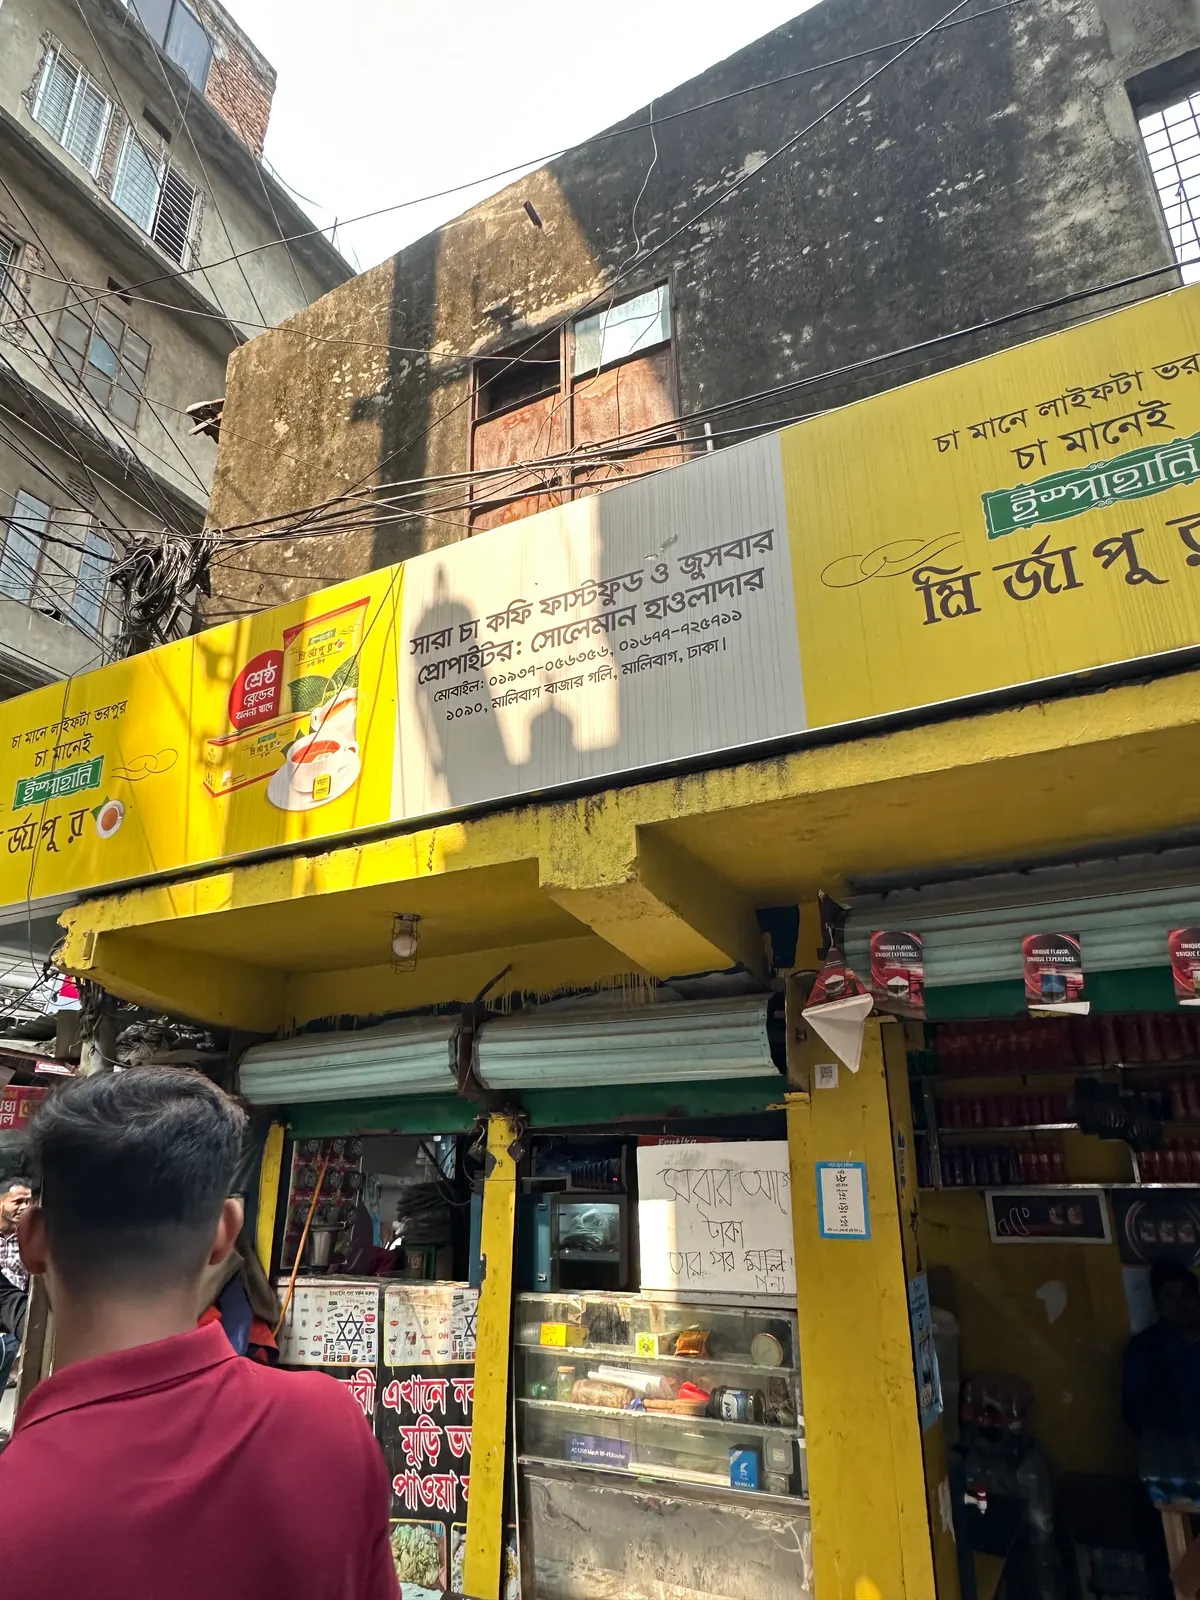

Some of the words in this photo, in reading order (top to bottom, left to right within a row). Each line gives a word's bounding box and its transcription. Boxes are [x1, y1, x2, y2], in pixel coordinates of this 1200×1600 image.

[932, 428, 961, 453] চা
[966, 408, 1028, 441] মানে
[1034, 370, 1144, 418] লাইফটা
[1010, 438, 1049, 470] চা
[1058, 399, 1176, 454] মানেই
[1009, 443, 1200, 523] ইস্পাহানি
[409, 626, 453, 656] সারা
[459, 618, 481, 643] চা
[486, 598, 533, 633] কফি
[540, 568, 644, 617] ফাস্টফুড
[650, 562, 670, 584] ও
[677, 528, 775, 580] জুসবার
[531, 604, 637, 653] সোলেমান
[643, 567, 765, 620] হাওলাদার
[244, 659, 278, 691] শ্রেষ্ঠ
[433, 678, 485, 703] মোবাইল:
[491, 685, 541, 709] মালিবাগ
[544, 674, 585, 695] বাজার
[11, 734, 22, 748] চা
[25, 726, 48, 744] মানে
[94, 700, 128, 720] ভরপুর
[34, 749, 49, 767] চা
[53, 733, 94, 762] মানেই
[23, 765, 93, 802] ইস্পাহানি
[696, 1203, 745, 1249] টাকা
[709, 1250, 735, 1272] পর
[382, 1374, 449, 1415] এখানে
[398, 1413, 443, 1471] মুড়ি
[392, 1467, 459, 1514] পাওয়া
